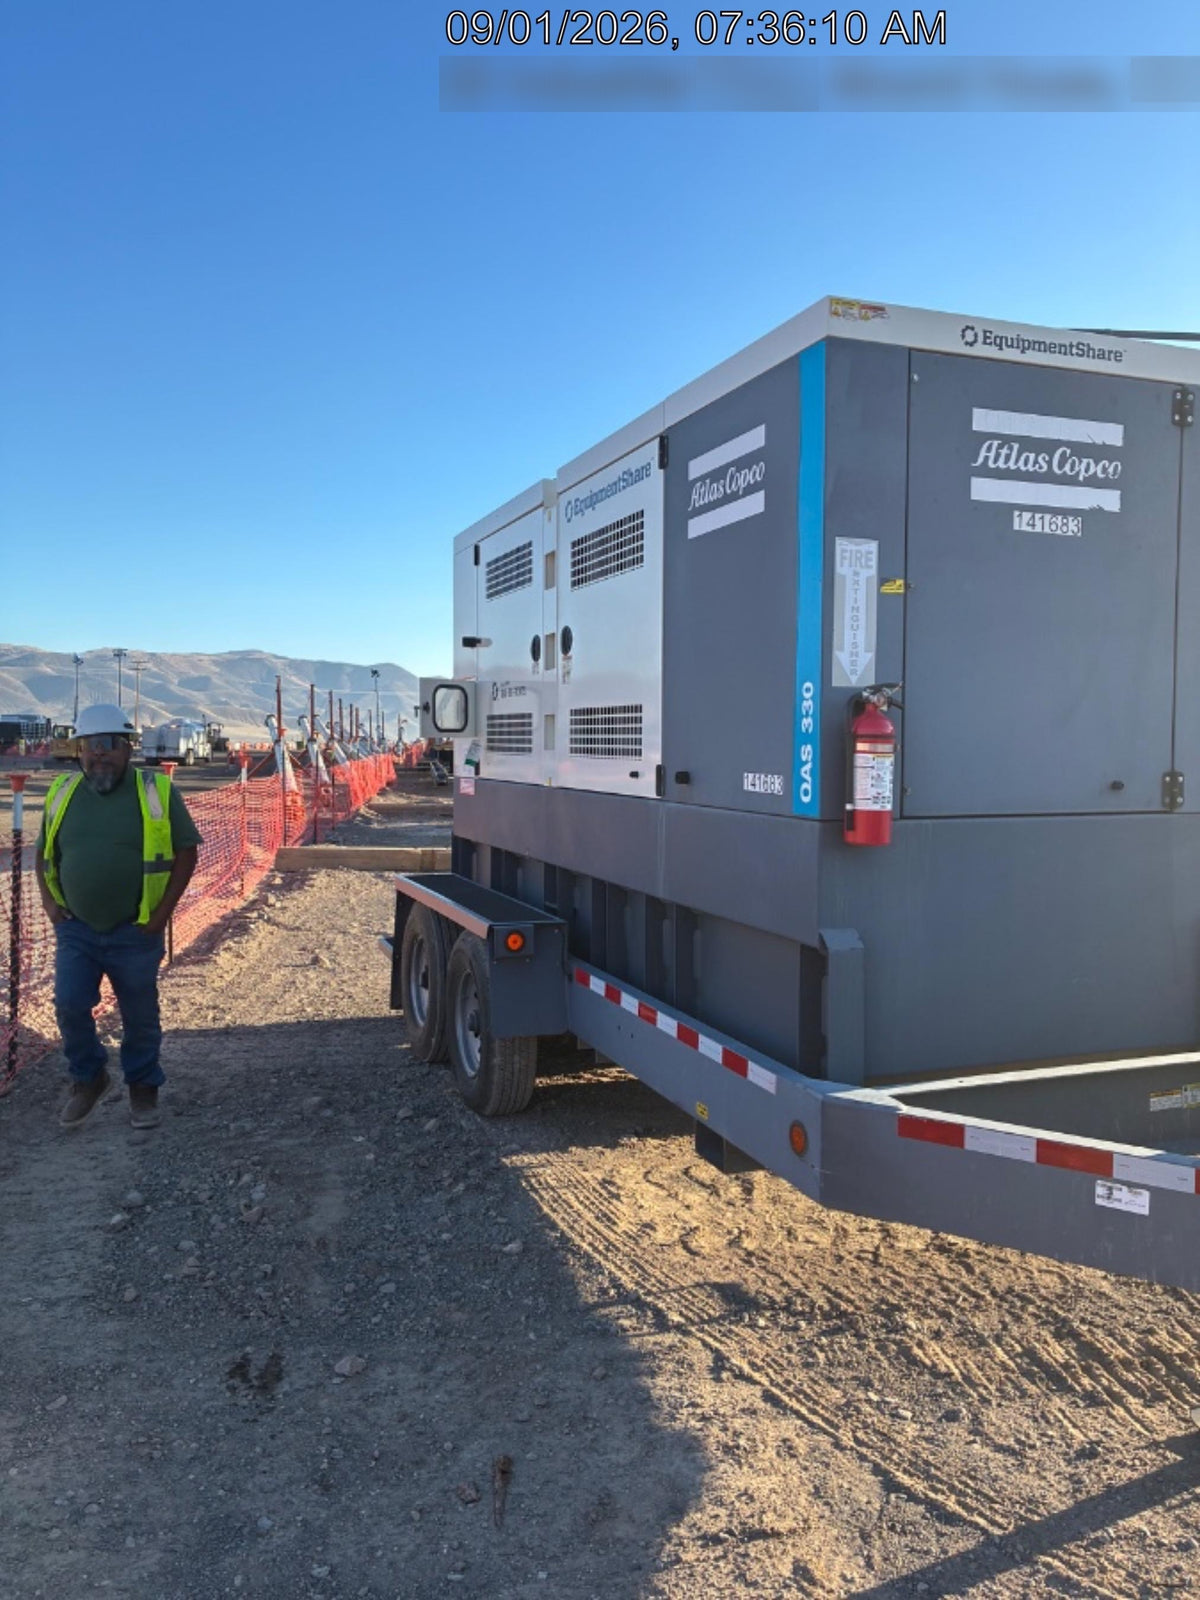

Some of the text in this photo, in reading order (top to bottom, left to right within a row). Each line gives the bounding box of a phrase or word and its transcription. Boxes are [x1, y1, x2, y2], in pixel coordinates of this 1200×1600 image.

[982, 329, 1123, 363] EquipmentShare
[971, 440, 1122, 482] Atlas Copco
[573, 461, 652, 517] EquipmentShare
[687, 460, 766, 512] Atlas Copco
[1014, 511, 1083, 537] 141683
[839, 548, 874, 569] FIRE
[800, 680, 815, 735] 330
